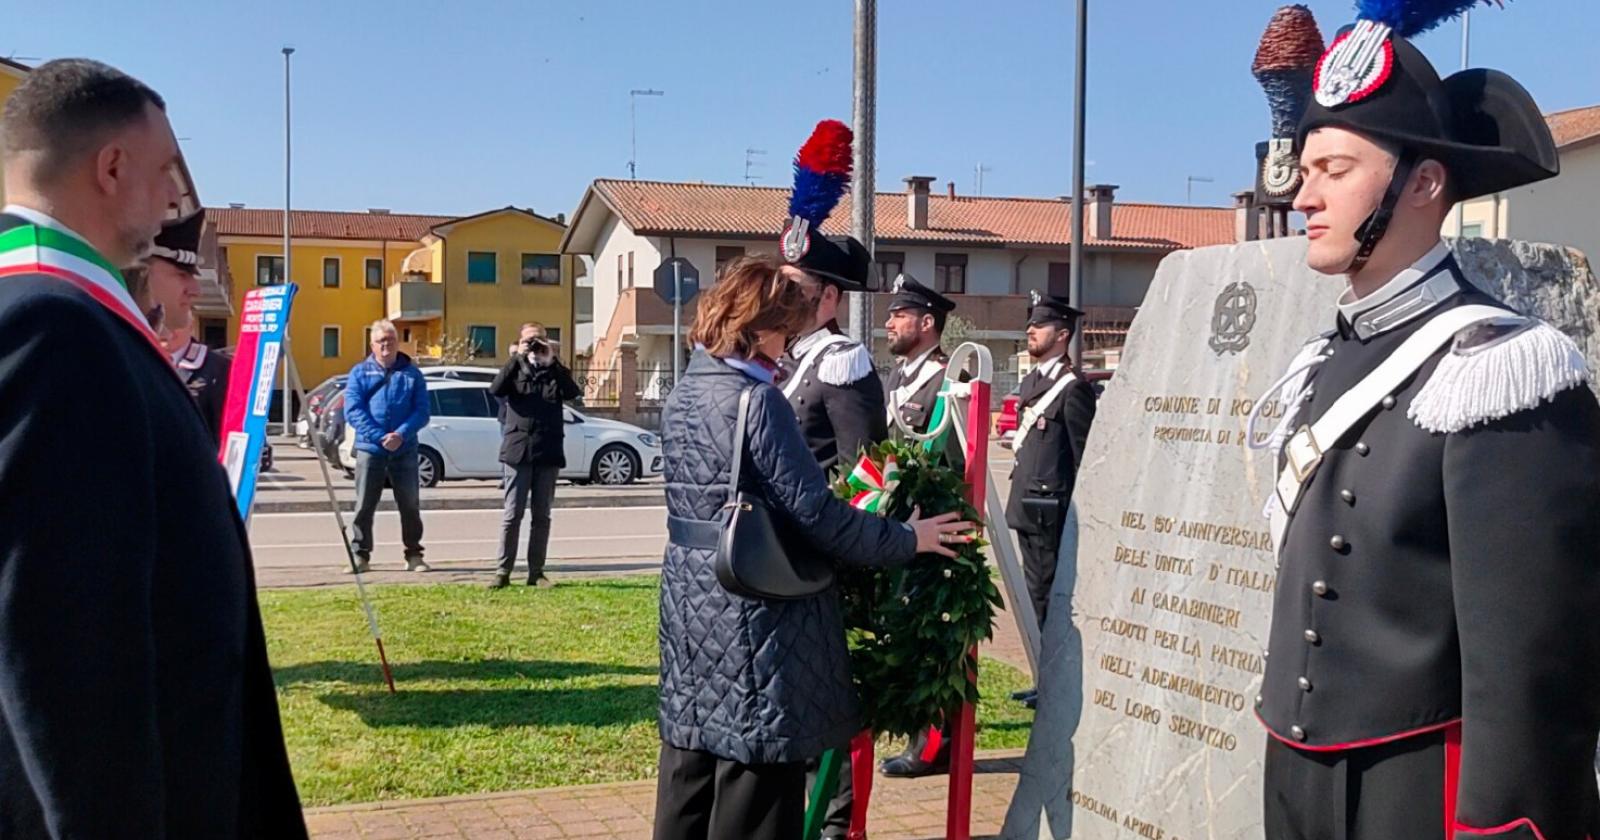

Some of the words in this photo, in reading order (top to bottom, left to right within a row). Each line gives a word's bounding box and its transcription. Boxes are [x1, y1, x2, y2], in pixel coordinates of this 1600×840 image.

[1144, 395, 1200, 415] COMUNE
[1206, 397, 1222, 415] DI
[1153, 426, 1212, 445] PROVINCIA
[1217, 429, 1231, 445] DI
[1236, 431, 1268, 446] RVI
[1121, 510, 1146, 531] NEL
[1113, 545, 1151, 569] DELL'
[1208, 562, 1223, 581] D'
[1227, 567, 1277, 593] ITALIA
[1131, 586, 1147, 605] AI
[1152, 591, 1241, 629] CARABINIERI
[1100, 616, 1149, 643] CADUTI
[1153, 629, 1179, 651] PER
[1182, 636, 1202, 659] LA
[1211, 644, 1263, 675] PATRIA
[1100, 653, 1137, 679] NELL'
[1141, 666, 1245, 712] ADEMPIMENTO
[1094, 688, 1117, 711] DEL
[1124, 698, 1162, 725] LORO
[1168, 715, 1237, 752] SERVIZIO
[1123, 814, 1165, 840] APRILE
